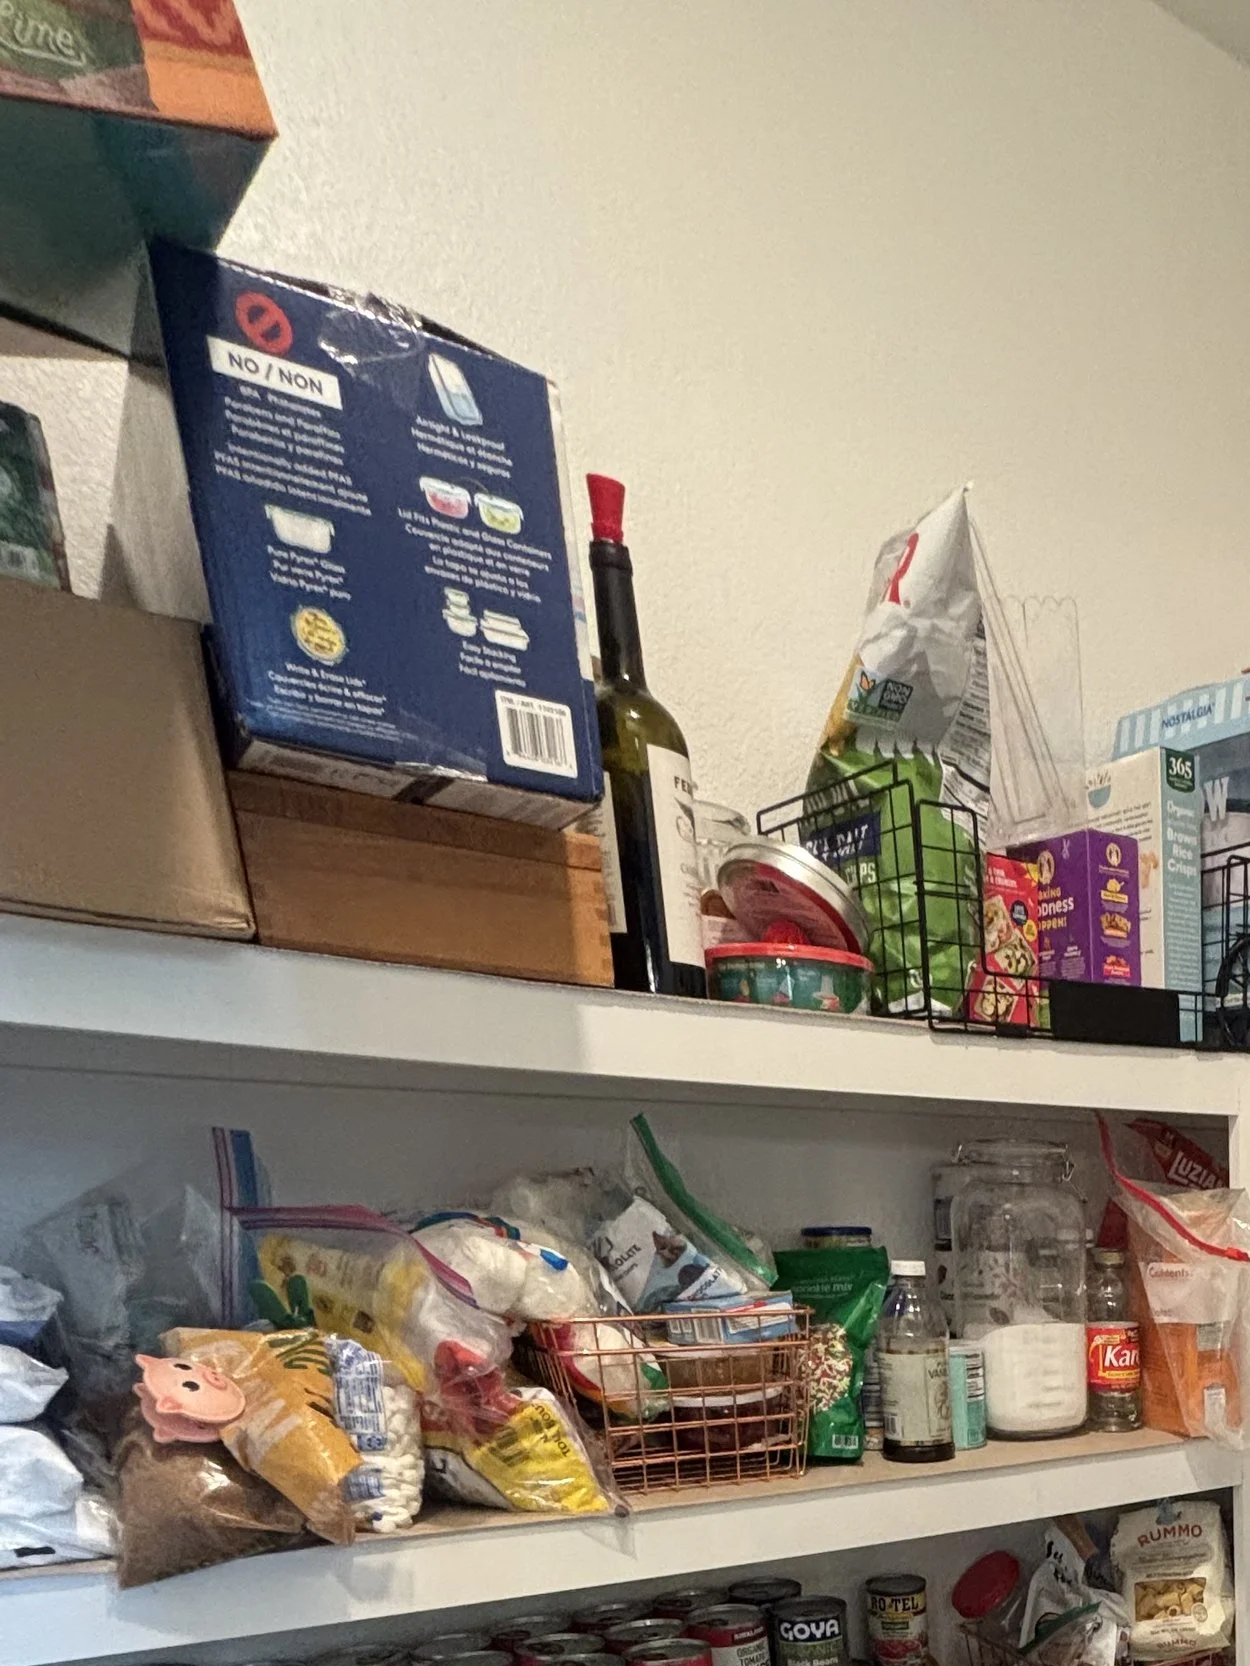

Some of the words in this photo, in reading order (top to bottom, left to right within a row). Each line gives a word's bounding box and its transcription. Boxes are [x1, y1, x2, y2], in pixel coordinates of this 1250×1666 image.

[228, 352, 259, 374] NO
[278, 368, 322, 395] NON
[1161, 704, 1214, 729] NOSTALGIA
[1168, 757, 1192, 778] 365
[1167, 827, 1197, 843] Brown
[1172, 844, 1194, 860] Rice
[1138, 1524, 1203, 1547] RUMMO
[780, 1619, 839, 1640] GOYA
